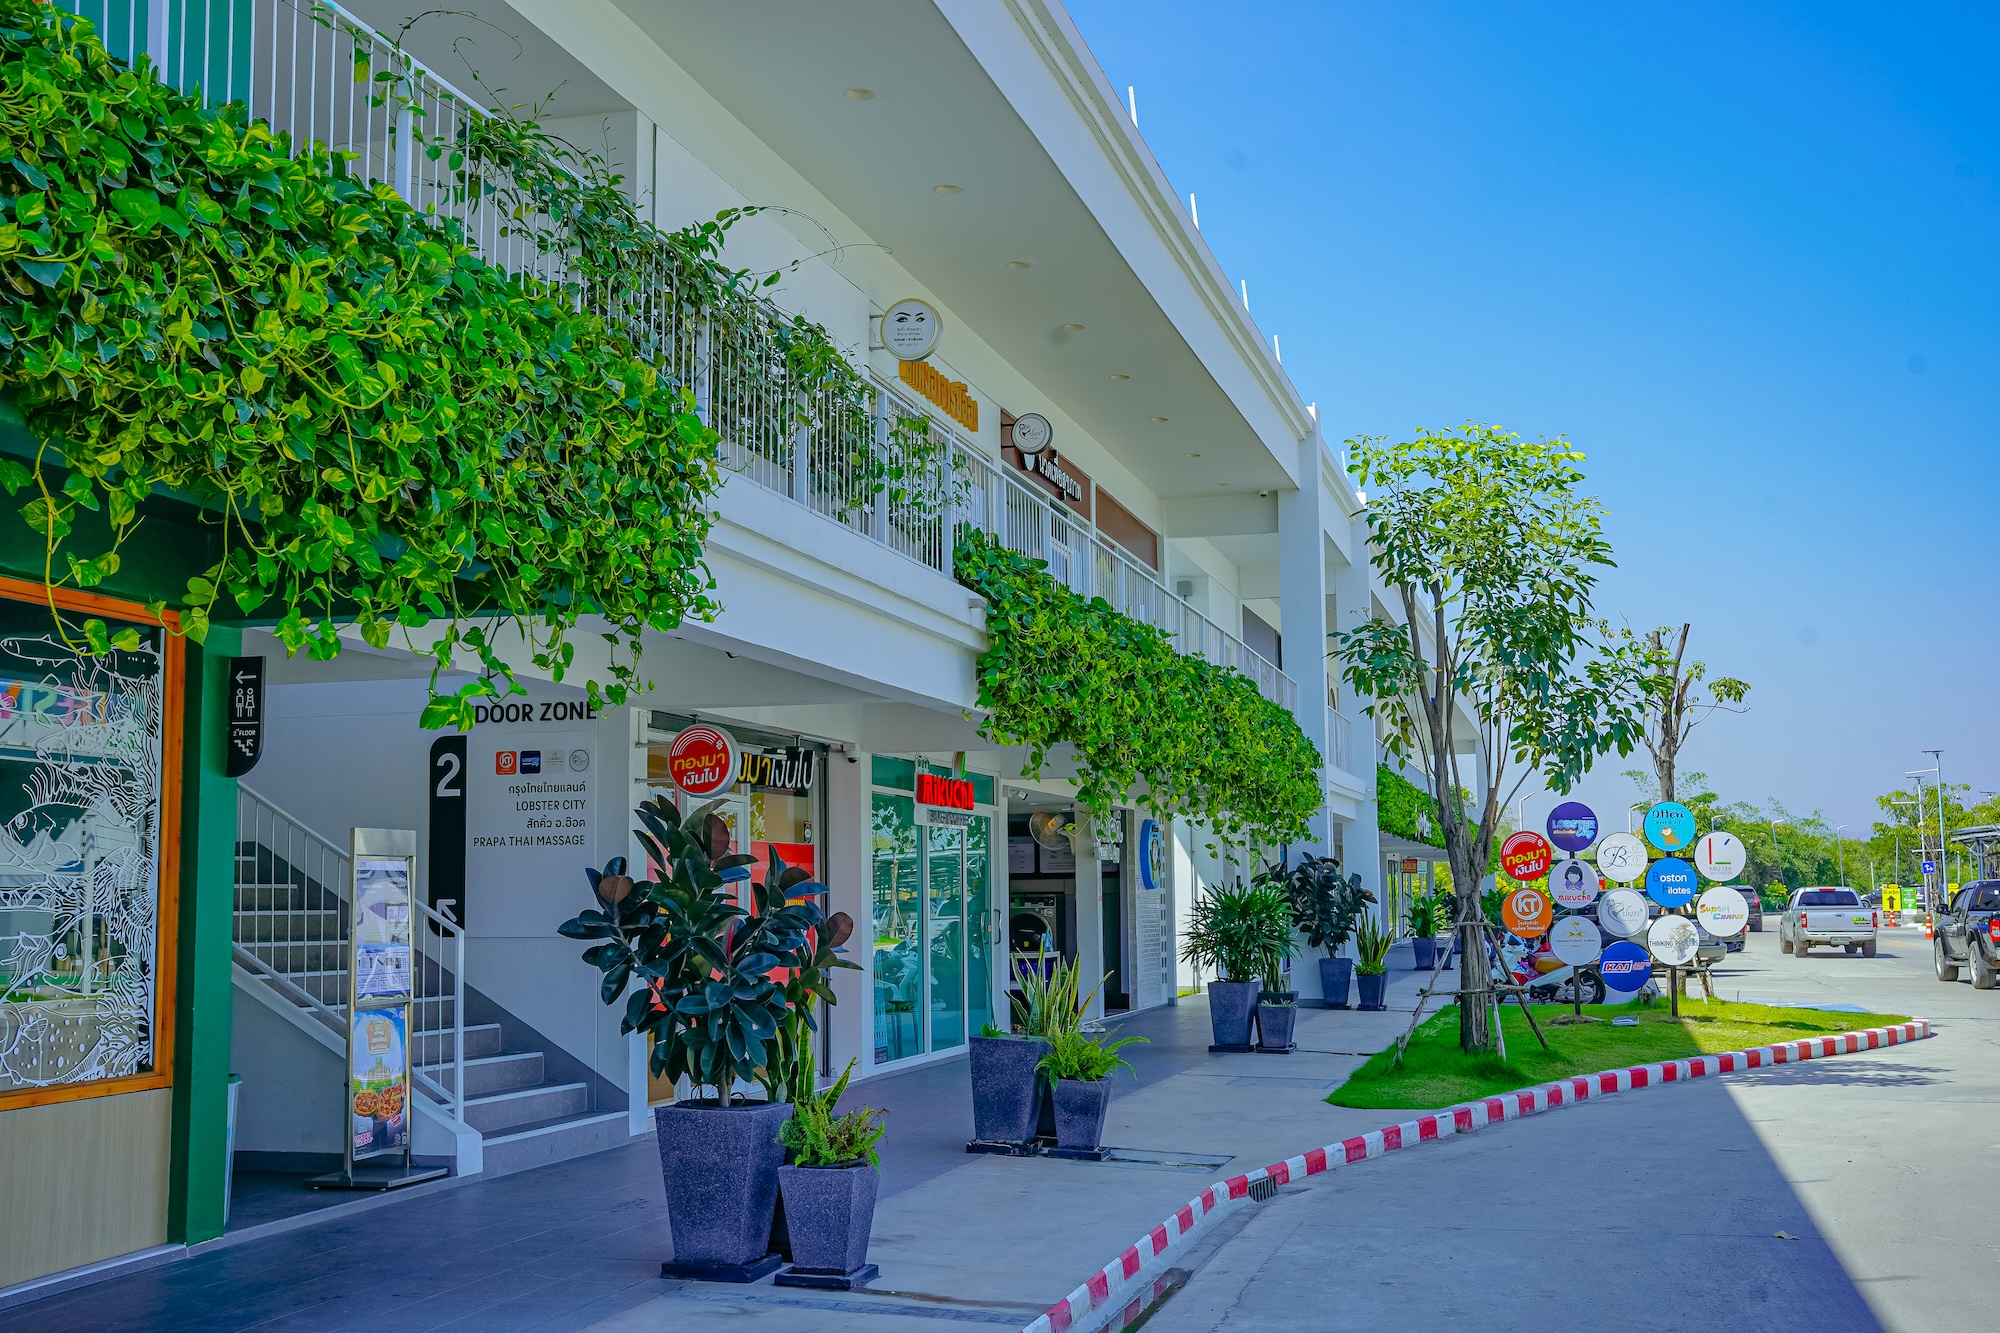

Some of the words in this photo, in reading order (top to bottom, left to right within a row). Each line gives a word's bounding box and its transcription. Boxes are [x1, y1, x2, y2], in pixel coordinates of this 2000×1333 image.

[540, 701, 597, 722] ZONE
[673, 752, 726, 772] ทองมา
[738, 746, 816, 790] งมาเงินไป
[436, 752, 461, 797] 2
[682, 766, 720, 787] เงินไป
[508, 780, 586, 797] กรุงไทยไทยแลนด์
[516, 800, 560, 812] LOBSTER
[562, 799, 586, 810] CITY
[526, 814, 553, 829] สักคิ้ว
[1652, 809, 1686, 819] Otteri
[473, 836, 506, 847] PRAPA
[508, 836, 533, 846] THAI
[536, 835, 586, 846] MASSAGE
[1506, 848, 1547, 866] ทองมา
[1515, 859, 1544, 876] เงินไป
[1652, 871, 1688, 882] Boston
[1662, 884, 1691, 895] Pilates
[1516, 897, 1539, 913] KT
[1605, 963, 1631, 971] KAI
